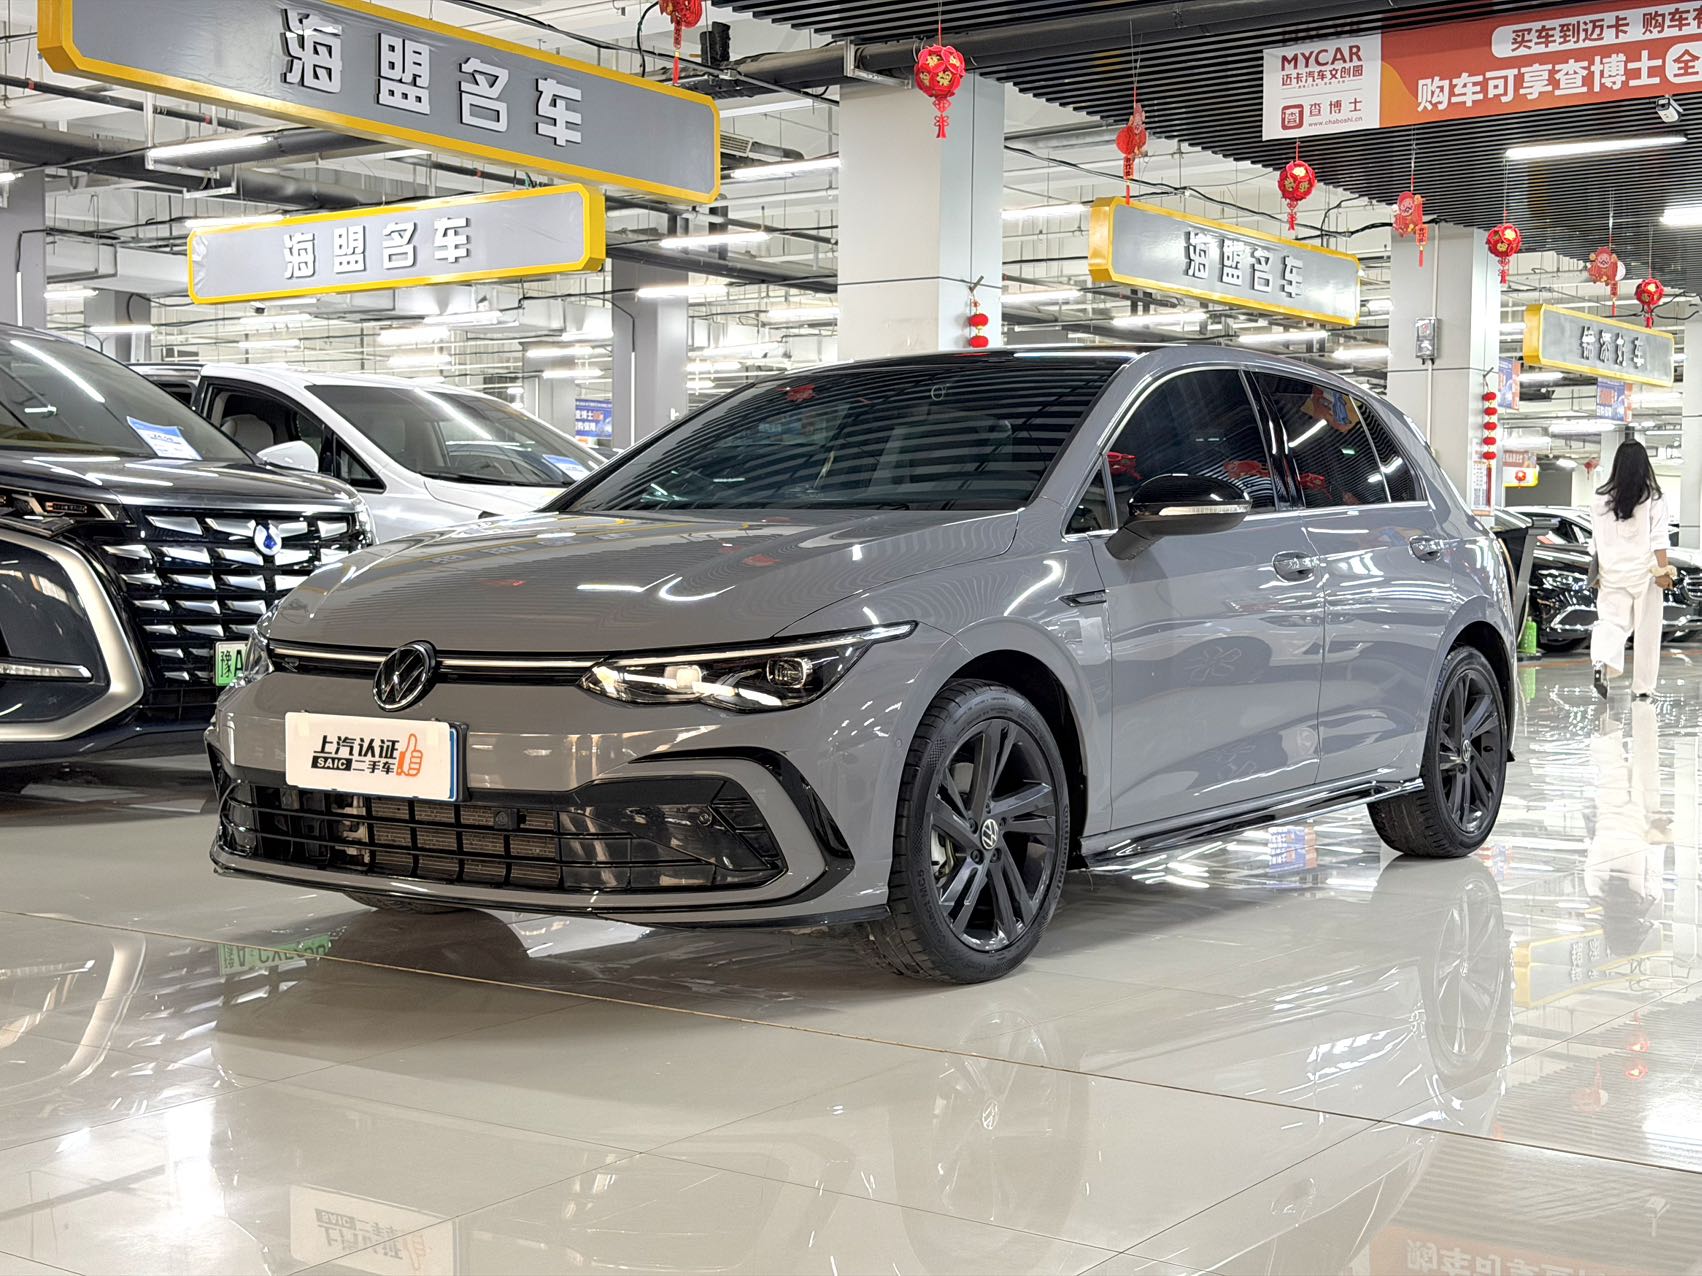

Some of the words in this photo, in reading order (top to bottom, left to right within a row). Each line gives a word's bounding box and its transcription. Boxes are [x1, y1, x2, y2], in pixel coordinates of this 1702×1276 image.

[1511, 15, 1630, 52] 买车到迈卡
[1281, 44, 1363, 71] MYCAR
[281, 8, 583, 147] 海盟名车
[1281, 64, 1363, 87] 迈卡汽车文创园
[1308, 97, 1363, 117] 查博士
[1308, 116, 1363, 128] www.chaboshi.cn
[283, 217, 471, 279] 海盟名车
[1184, 227, 1303, 299] 海盟名车
[313, 735, 400, 760] 上汽认证
[316, 758, 347, 770] SAIC
[352, 761, 396, 775] 二手车
